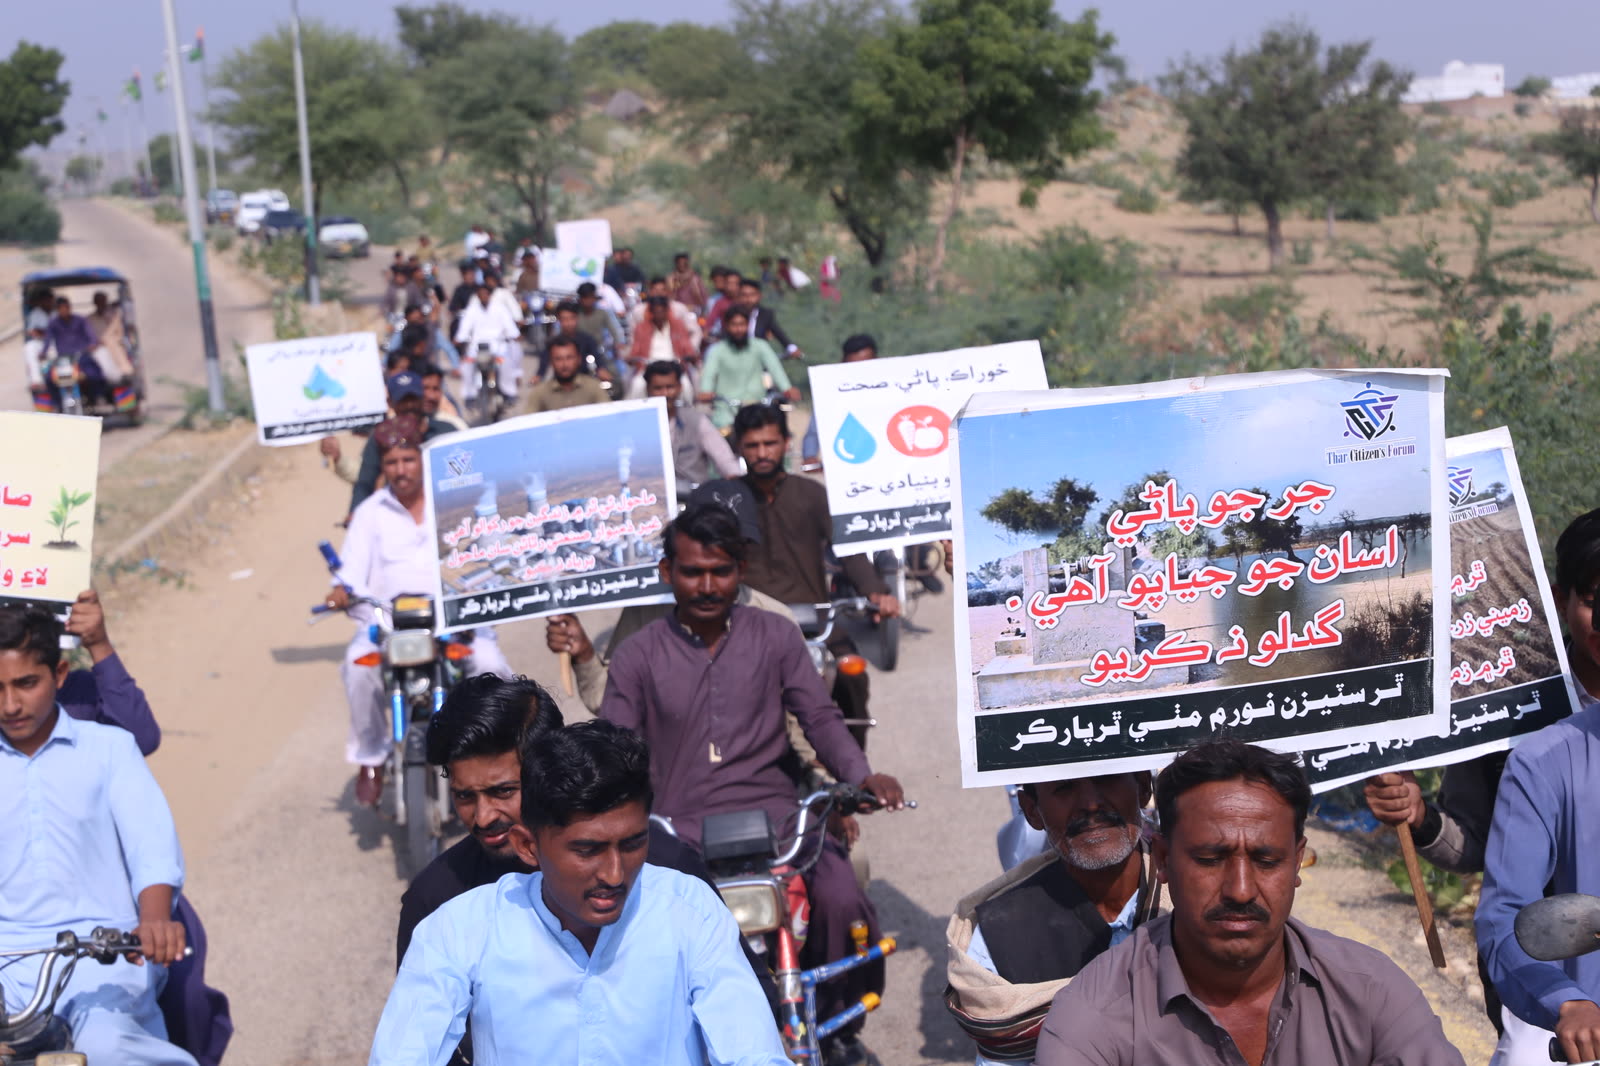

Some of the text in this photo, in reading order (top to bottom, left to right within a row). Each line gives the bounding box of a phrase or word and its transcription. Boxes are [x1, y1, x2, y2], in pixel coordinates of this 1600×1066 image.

[838, 381, 889, 393] صحت
[1326, 444, 1416, 465] Thar Citizen's Forum
[846, 482, 874, 498] حق
[880, 474, 939, 496] بنيادي
[1107, 478, 1335, 548] جر جو پاڻي
[1473, 503, 1499, 518] Forum
[1307, 525, 1398, 583] اسان
[1118, 553, 1236, 611] جياپو
[1238, 558, 1305, 595] جو
[1249, 599, 1345, 667] گدلو
[1478, 598, 1532, 638] زميني
[1080, 632, 1213, 686] ڪريو
[1009, 673, 1405, 752] ٿر سٽيزن فورم مٺي ٿرپارڪر
[1450, 703, 1510, 735] سٽيز
[1512, 689, 1543, 720] ٿر
